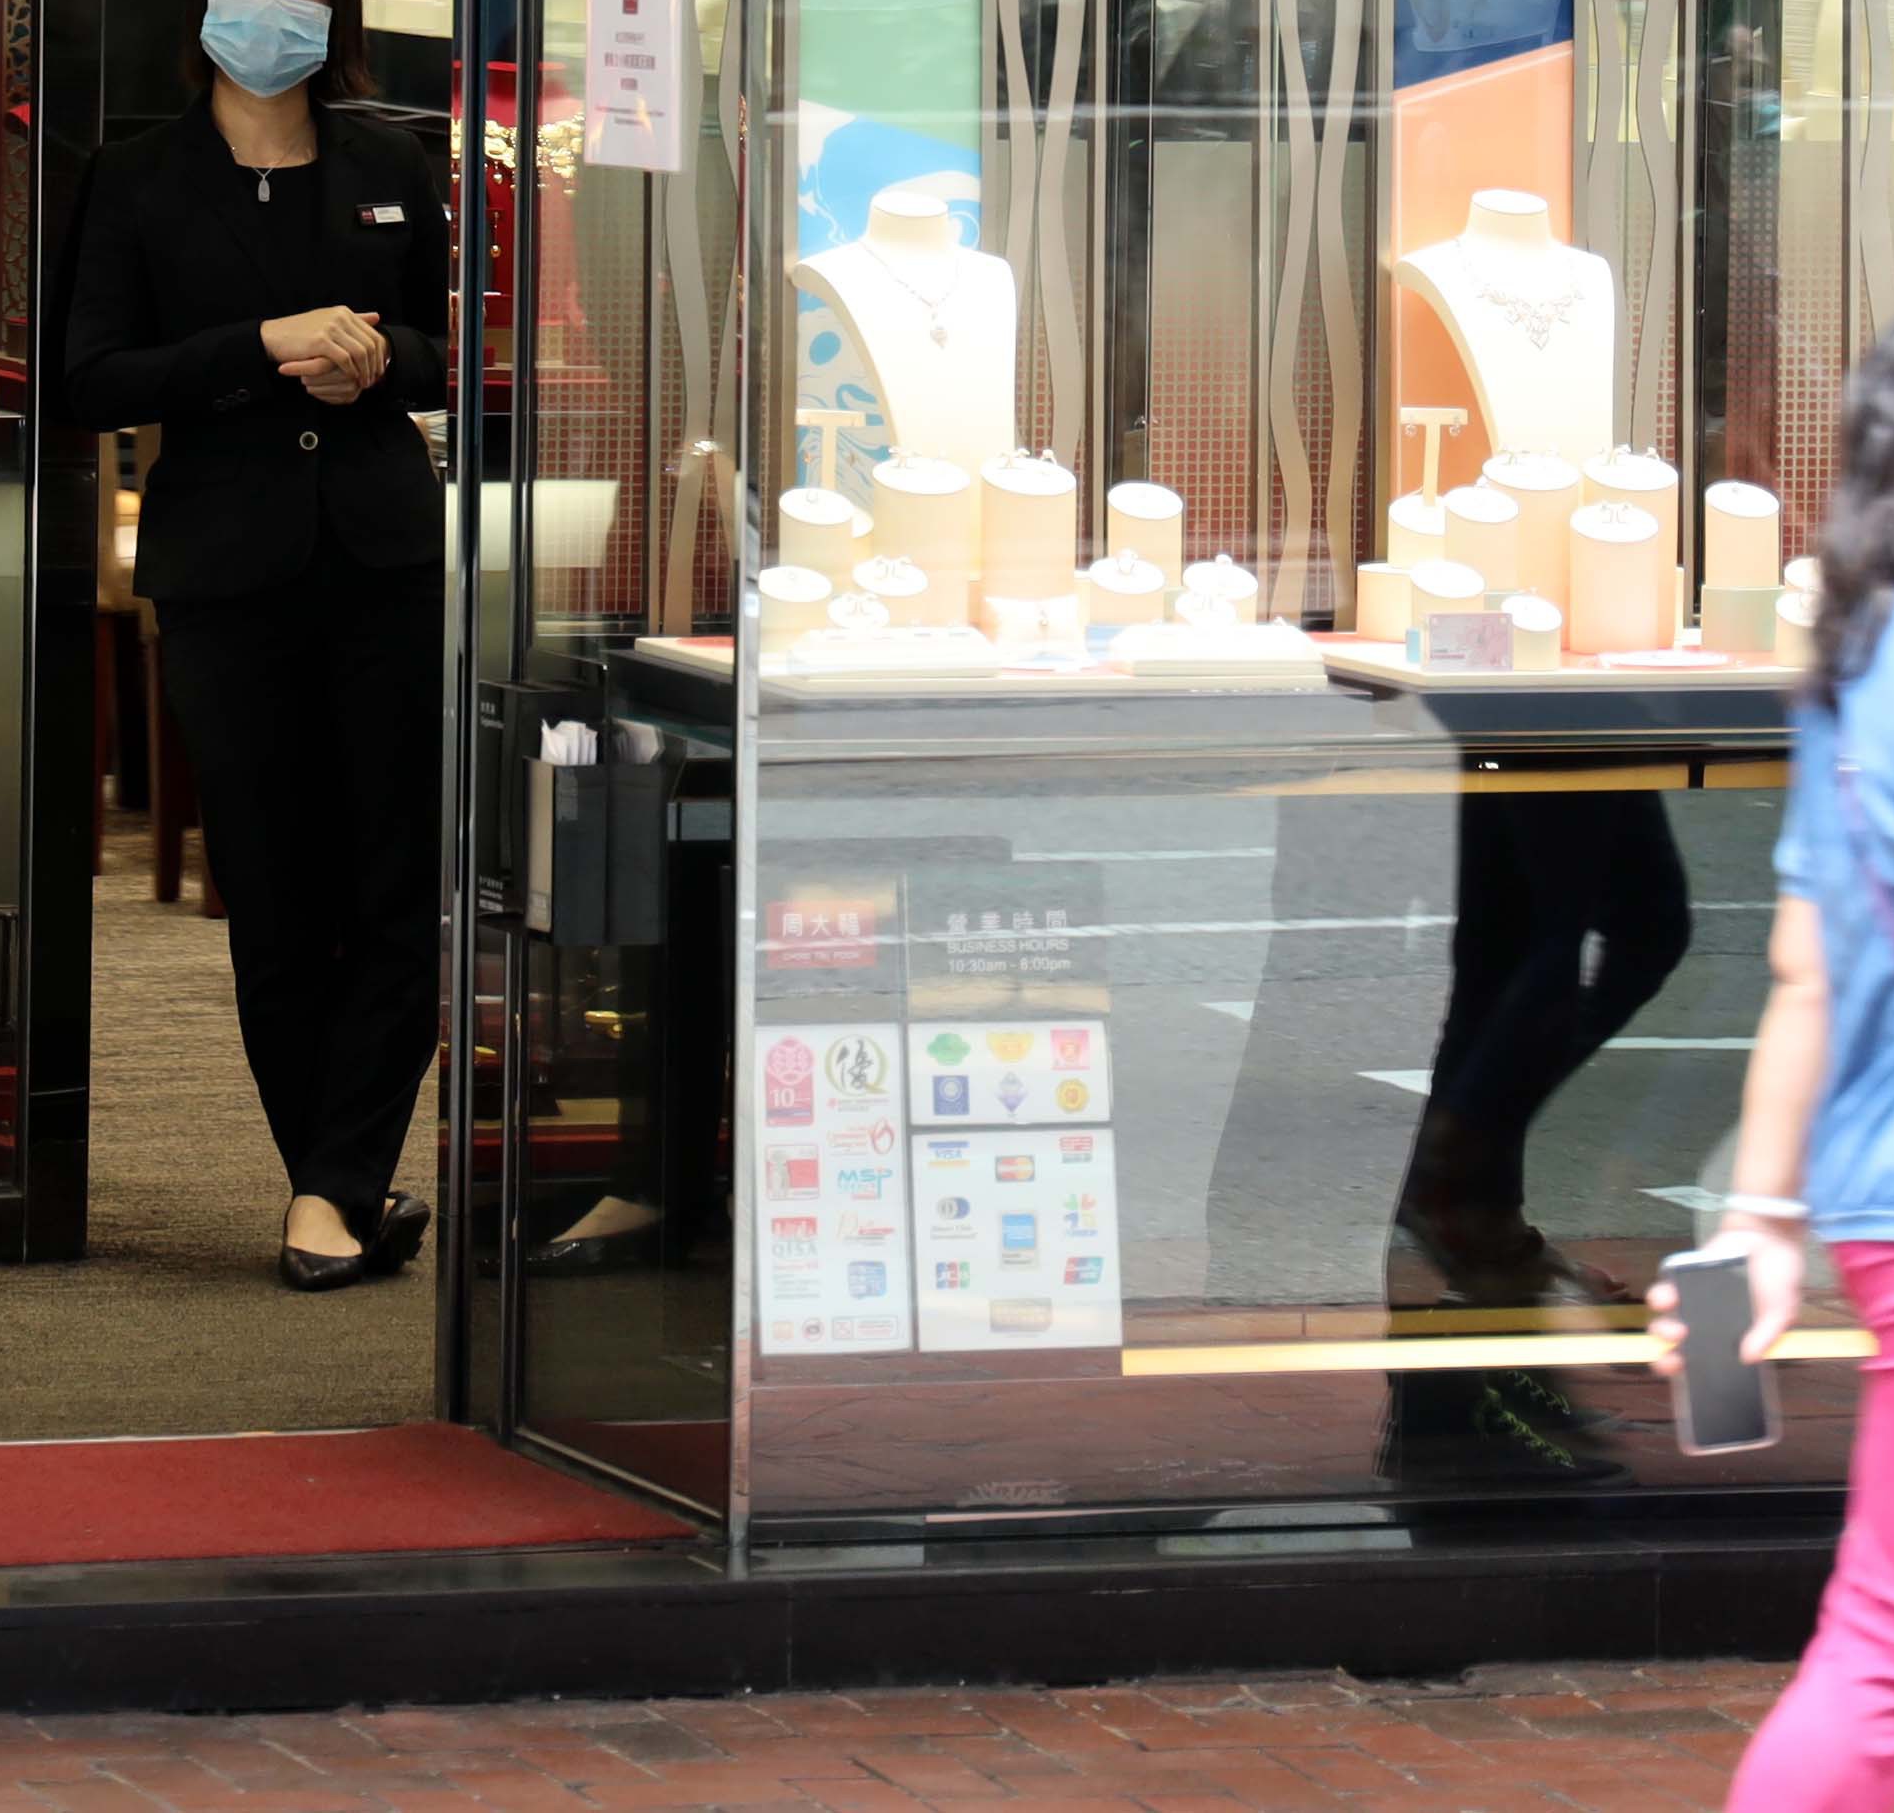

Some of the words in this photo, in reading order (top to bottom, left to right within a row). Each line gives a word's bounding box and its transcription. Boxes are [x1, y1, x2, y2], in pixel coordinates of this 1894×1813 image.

[782, 912, 861, 938] 周大福
[947, 938, 1017, 954] BUSINESS
[1018, 937, 1070, 952] HOURS
